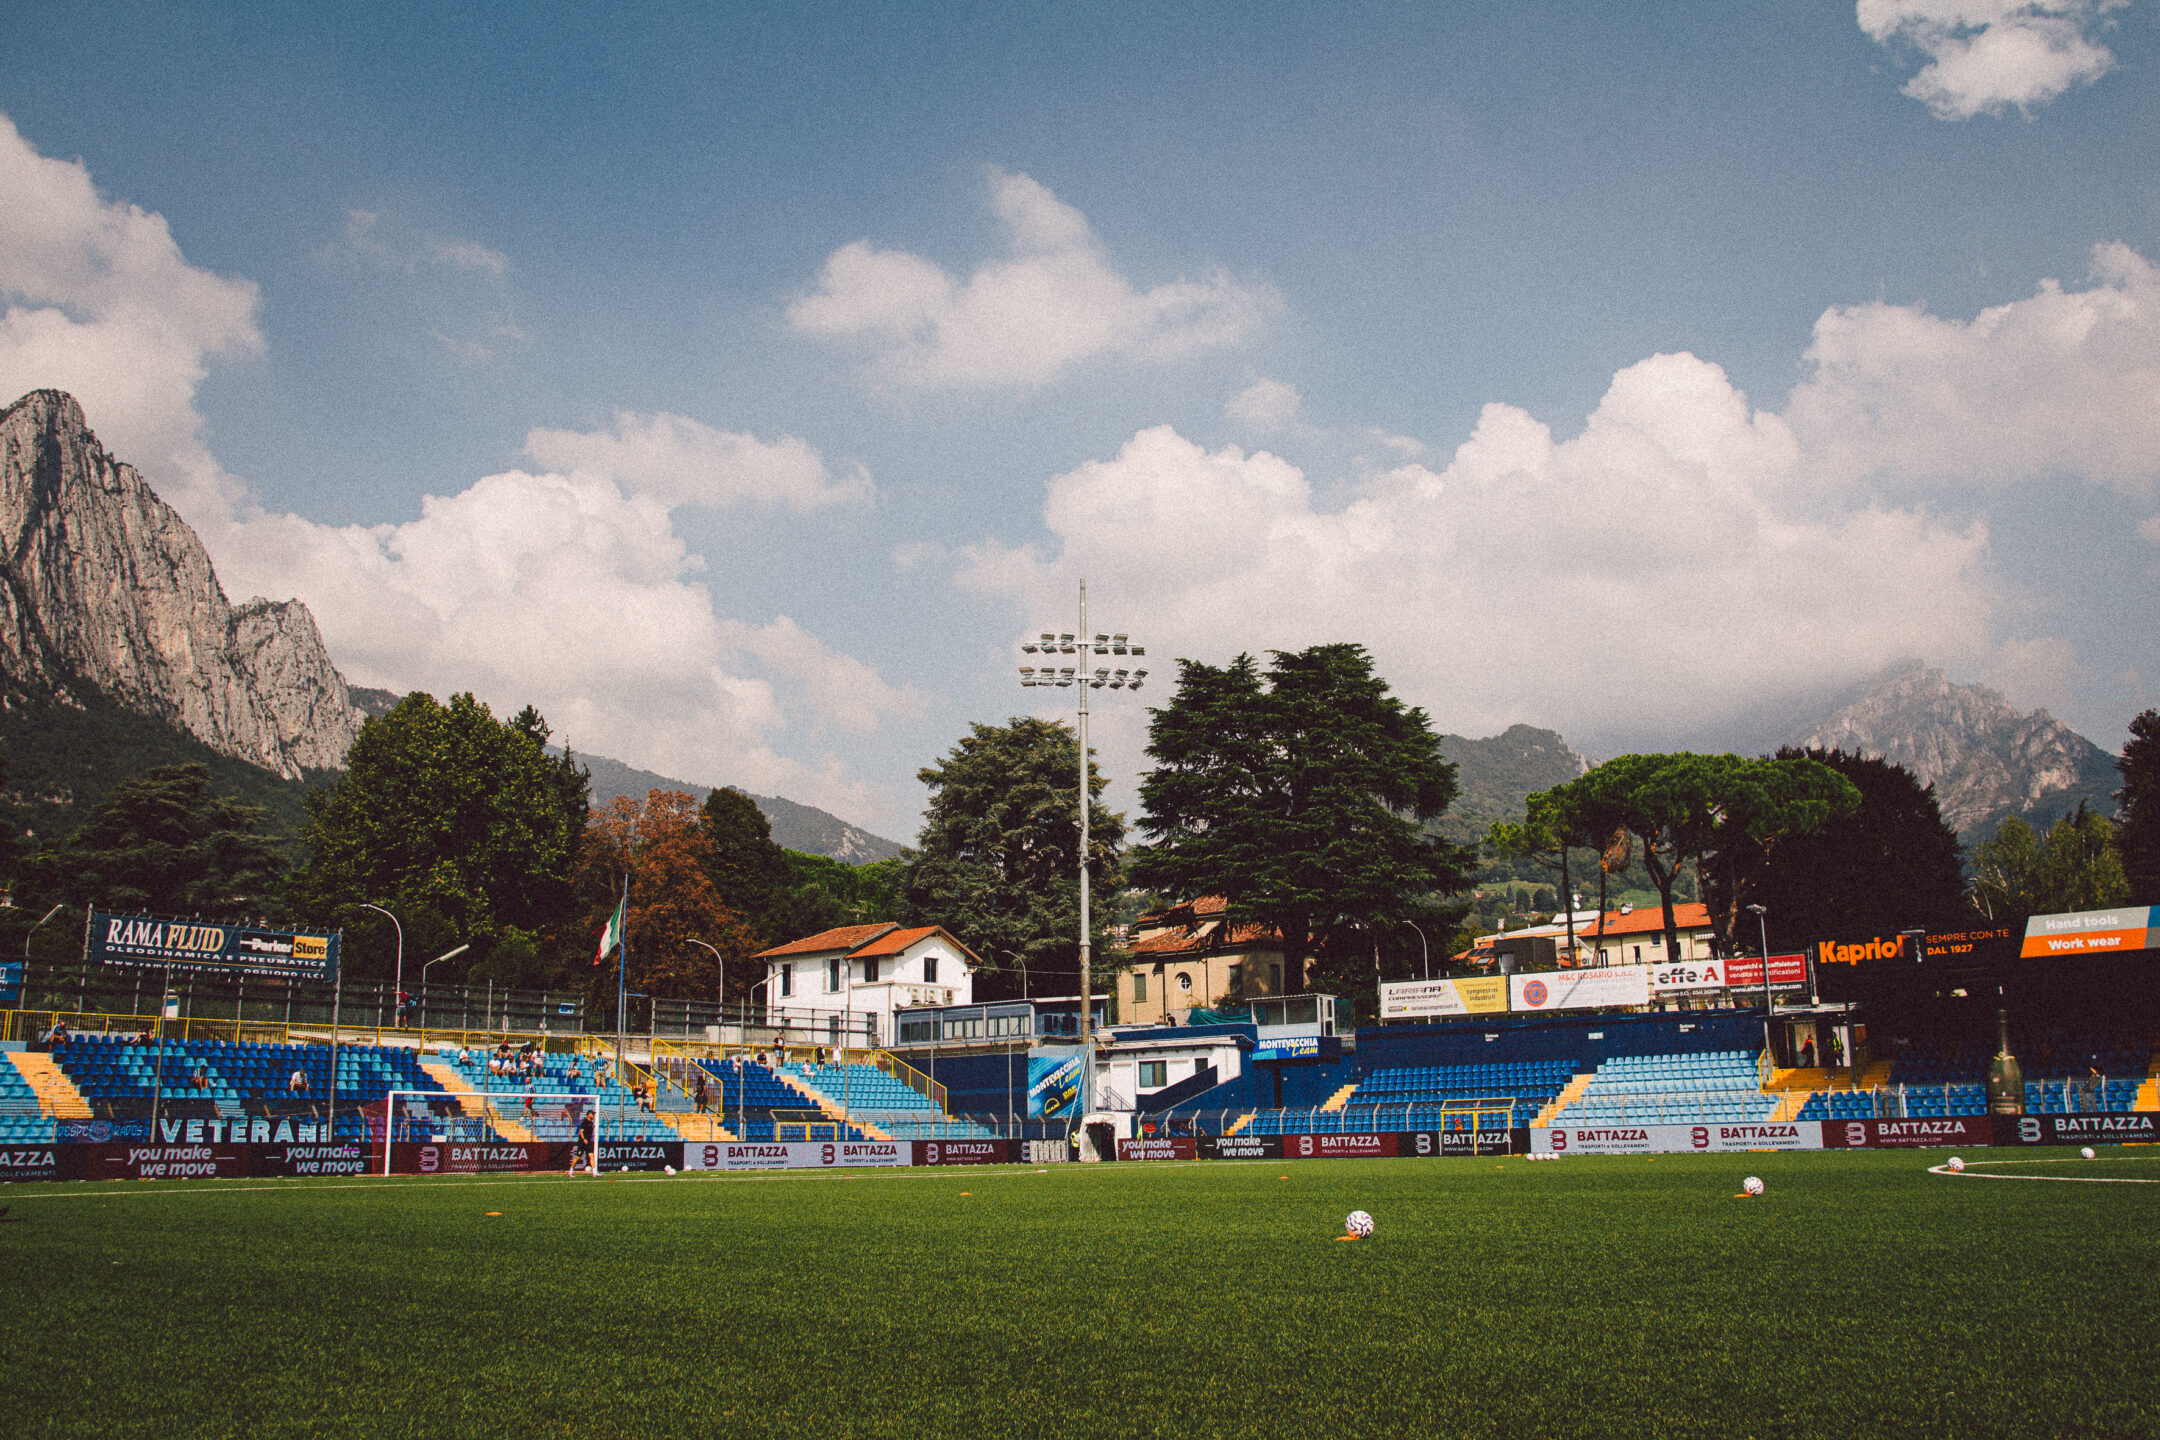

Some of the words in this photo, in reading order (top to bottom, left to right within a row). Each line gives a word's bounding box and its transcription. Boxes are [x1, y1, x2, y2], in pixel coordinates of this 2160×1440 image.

[2046, 918, 2080, 930] Hand
[2084, 915, 2119, 926] tools
[106, 918, 162, 947] RAMA
[165, 924, 224, 952] FLUID
[1926, 932, 1967, 944] SEMPRE
[1970, 931, 1994, 940] CON
[1996, 928, 2009, 938] TE
[252, 937, 292, 953] Parker
[295, 942, 325, 955] Store
[1927, 946, 1948, 955] DAL
[1950, 943, 1974, 954] 1927
[2048, 938, 2084, 950] Work
[2087, 936, 2122, 947] wear
[105, 945, 221, 960] OLEODINAMICA
[240, 956, 327, 967] PNEUMATICA
[1767, 960, 1801, 968] caffalature
[243, 967, 298, 977] OGGIONO
[1577, 970, 1613, 981] ROSARIO
[1759, 968, 1801, 977] ctificazioni
[1258, 1037, 1319, 1050] MONTEVECCHIA
[1286, 1043, 1318, 1057] Team
[1029, 1055, 1080, 1099] MONTEVECCHIA
[1052, 1067, 1080, 1089] Team
[1878, 1121, 1967, 1135] BATTAZZA
[2055, 1116, 2154, 1131] BATTAZZA
[159, 1118, 328, 1143] VETERANI
[1577, 1129, 1649, 1141] BATTAZZA
[1720, 1126, 1799, 1139] BATTAZZA
[1122, 1140, 1142, 1152] you
[1143, 1138, 1171, 1148] make
[1216, 1137, 1234, 1149] you
[1234, 1135, 1261, 1146] make
[1321, 1136, 1380, 1147] BATTAZZA
[1443, 1133, 1512, 1145] BATTAZZA
[127, 1148, 161, 1165] you
[164, 1145, 212, 1160] make
[285, 1147, 317, 1163] you
[317, 1144, 360, 1158] make
[451, 1147, 529, 1160] BATTAZZA
[599, 1146, 666, 1159] BATTAZZA
[728, 1146, 788, 1157] BATTAZZA
[843, 1144, 897, 1155] BATTAZZA
[946, 1143, 994, 1154] BATTAZZA
[1130, 1150, 1145, 1159] we
[1146, 1150, 1175, 1159] move
[1223, 1147, 1237, 1156] we
[1238, 1147, 1264, 1156] move
[0, 1151, 56, 1166] AZZA
[140, 1162, 166, 1176] we
[169, 1162, 217, 1175] move
[296, 1161, 320, 1173] we
[321, 1160, 364, 1173] move
